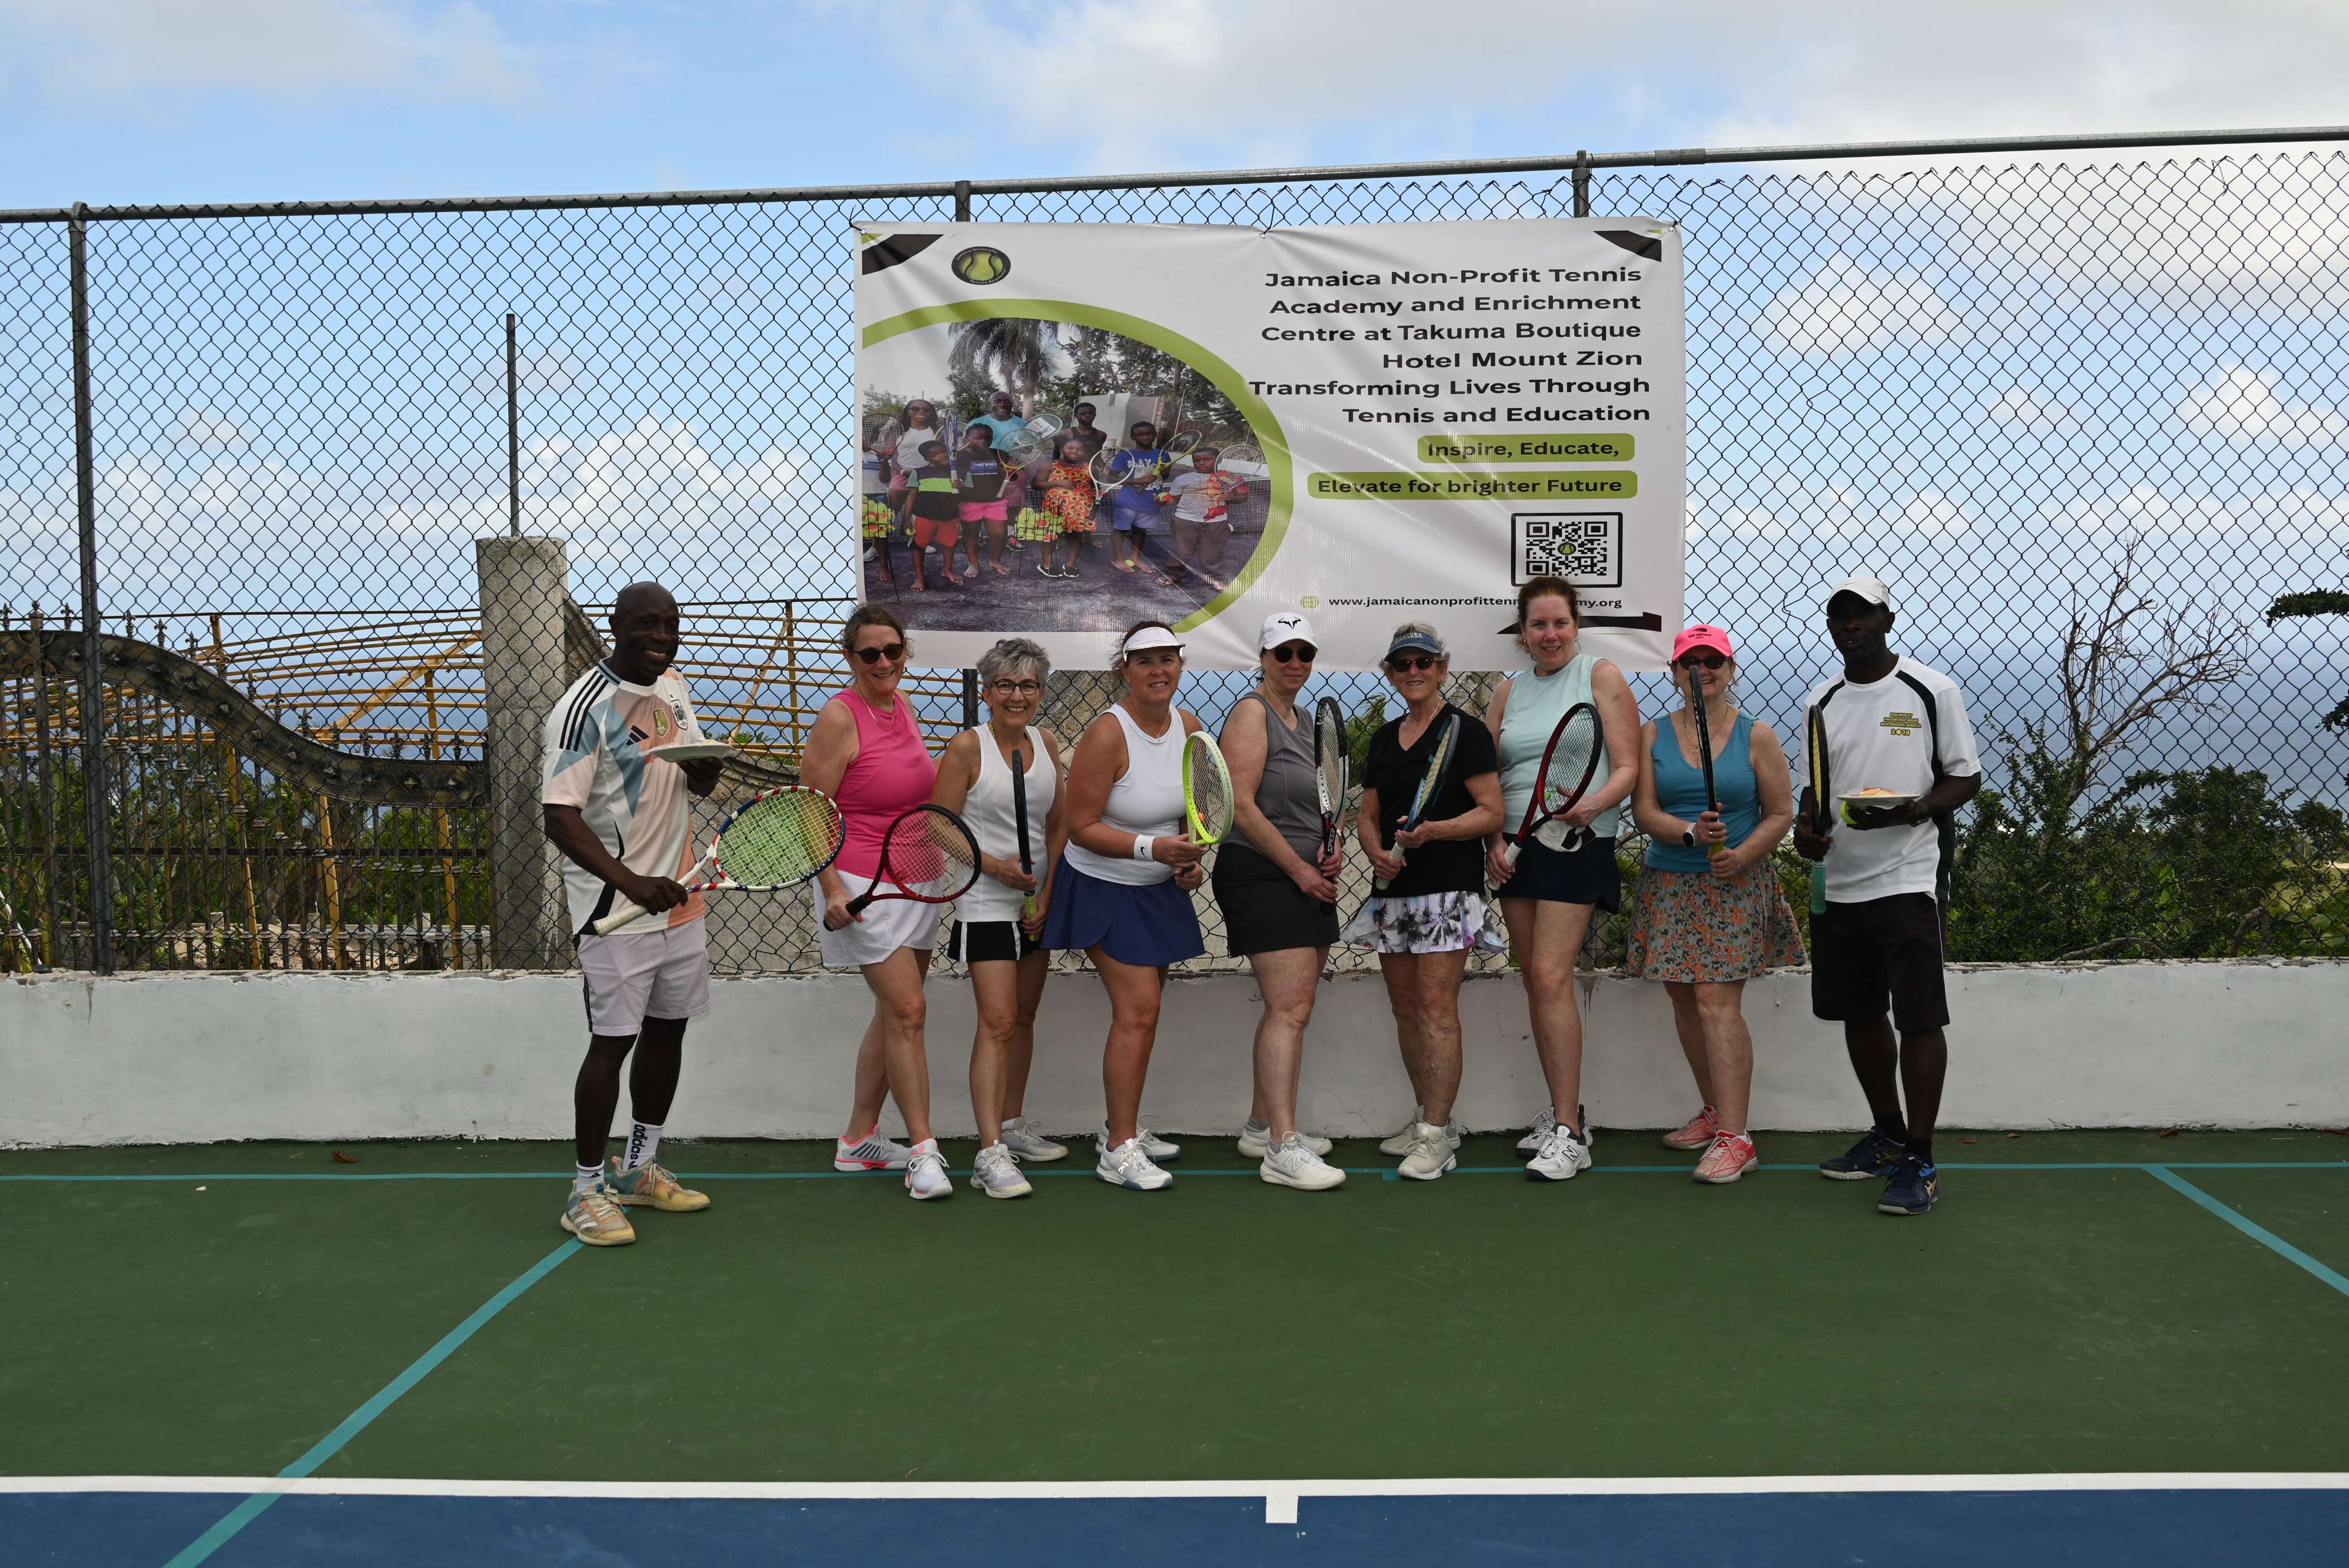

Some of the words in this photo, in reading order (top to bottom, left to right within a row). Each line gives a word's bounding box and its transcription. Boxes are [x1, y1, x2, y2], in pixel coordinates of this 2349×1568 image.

[1265, 271, 1380, 286] Jamaica
[1391, 268, 1541, 284] Non-Profit
[1548, 267, 1641, 282] Tennis
[1270, 300, 1403, 316] Academy
[1411, 297, 1464, 311] and
[1475, 295, 1641, 310] Enrichment
[1261, 327, 1356, 341] Centre
[1364, 327, 1392, 341] at
[1397, 325, 1505, 340] Takuma
[1516, 322, 1641, 341] Boutique
[1383, 353, 1460, 368] Hotel
[1472, 352, 1567, 367] Mount
[1576, 351, 1642, 366] Zion
[1248, 380, 1440, 399] Transforming
[1450, 379, 1521, 395] Lives
[1528, 378, 1650, 396] Through
[1342, 408, 1434, 423] Tennis
[1443, 407, 1496, 423] and
[1507, 405, 1650, 422] Education
[1429, 442, 1513, 459] Inspire,
[1520, 442, 1619, 457] Educate,
[1318, 479, 1402, 493] Elevate
[1407, 479, 1441, 493] for
[1448, 479, 1541, 496] brighter
[1547, 479, 1622, 492] Future
[1328, 828, 1336, 854] SPEED
[630, 1124, 648, 1160] adidas
